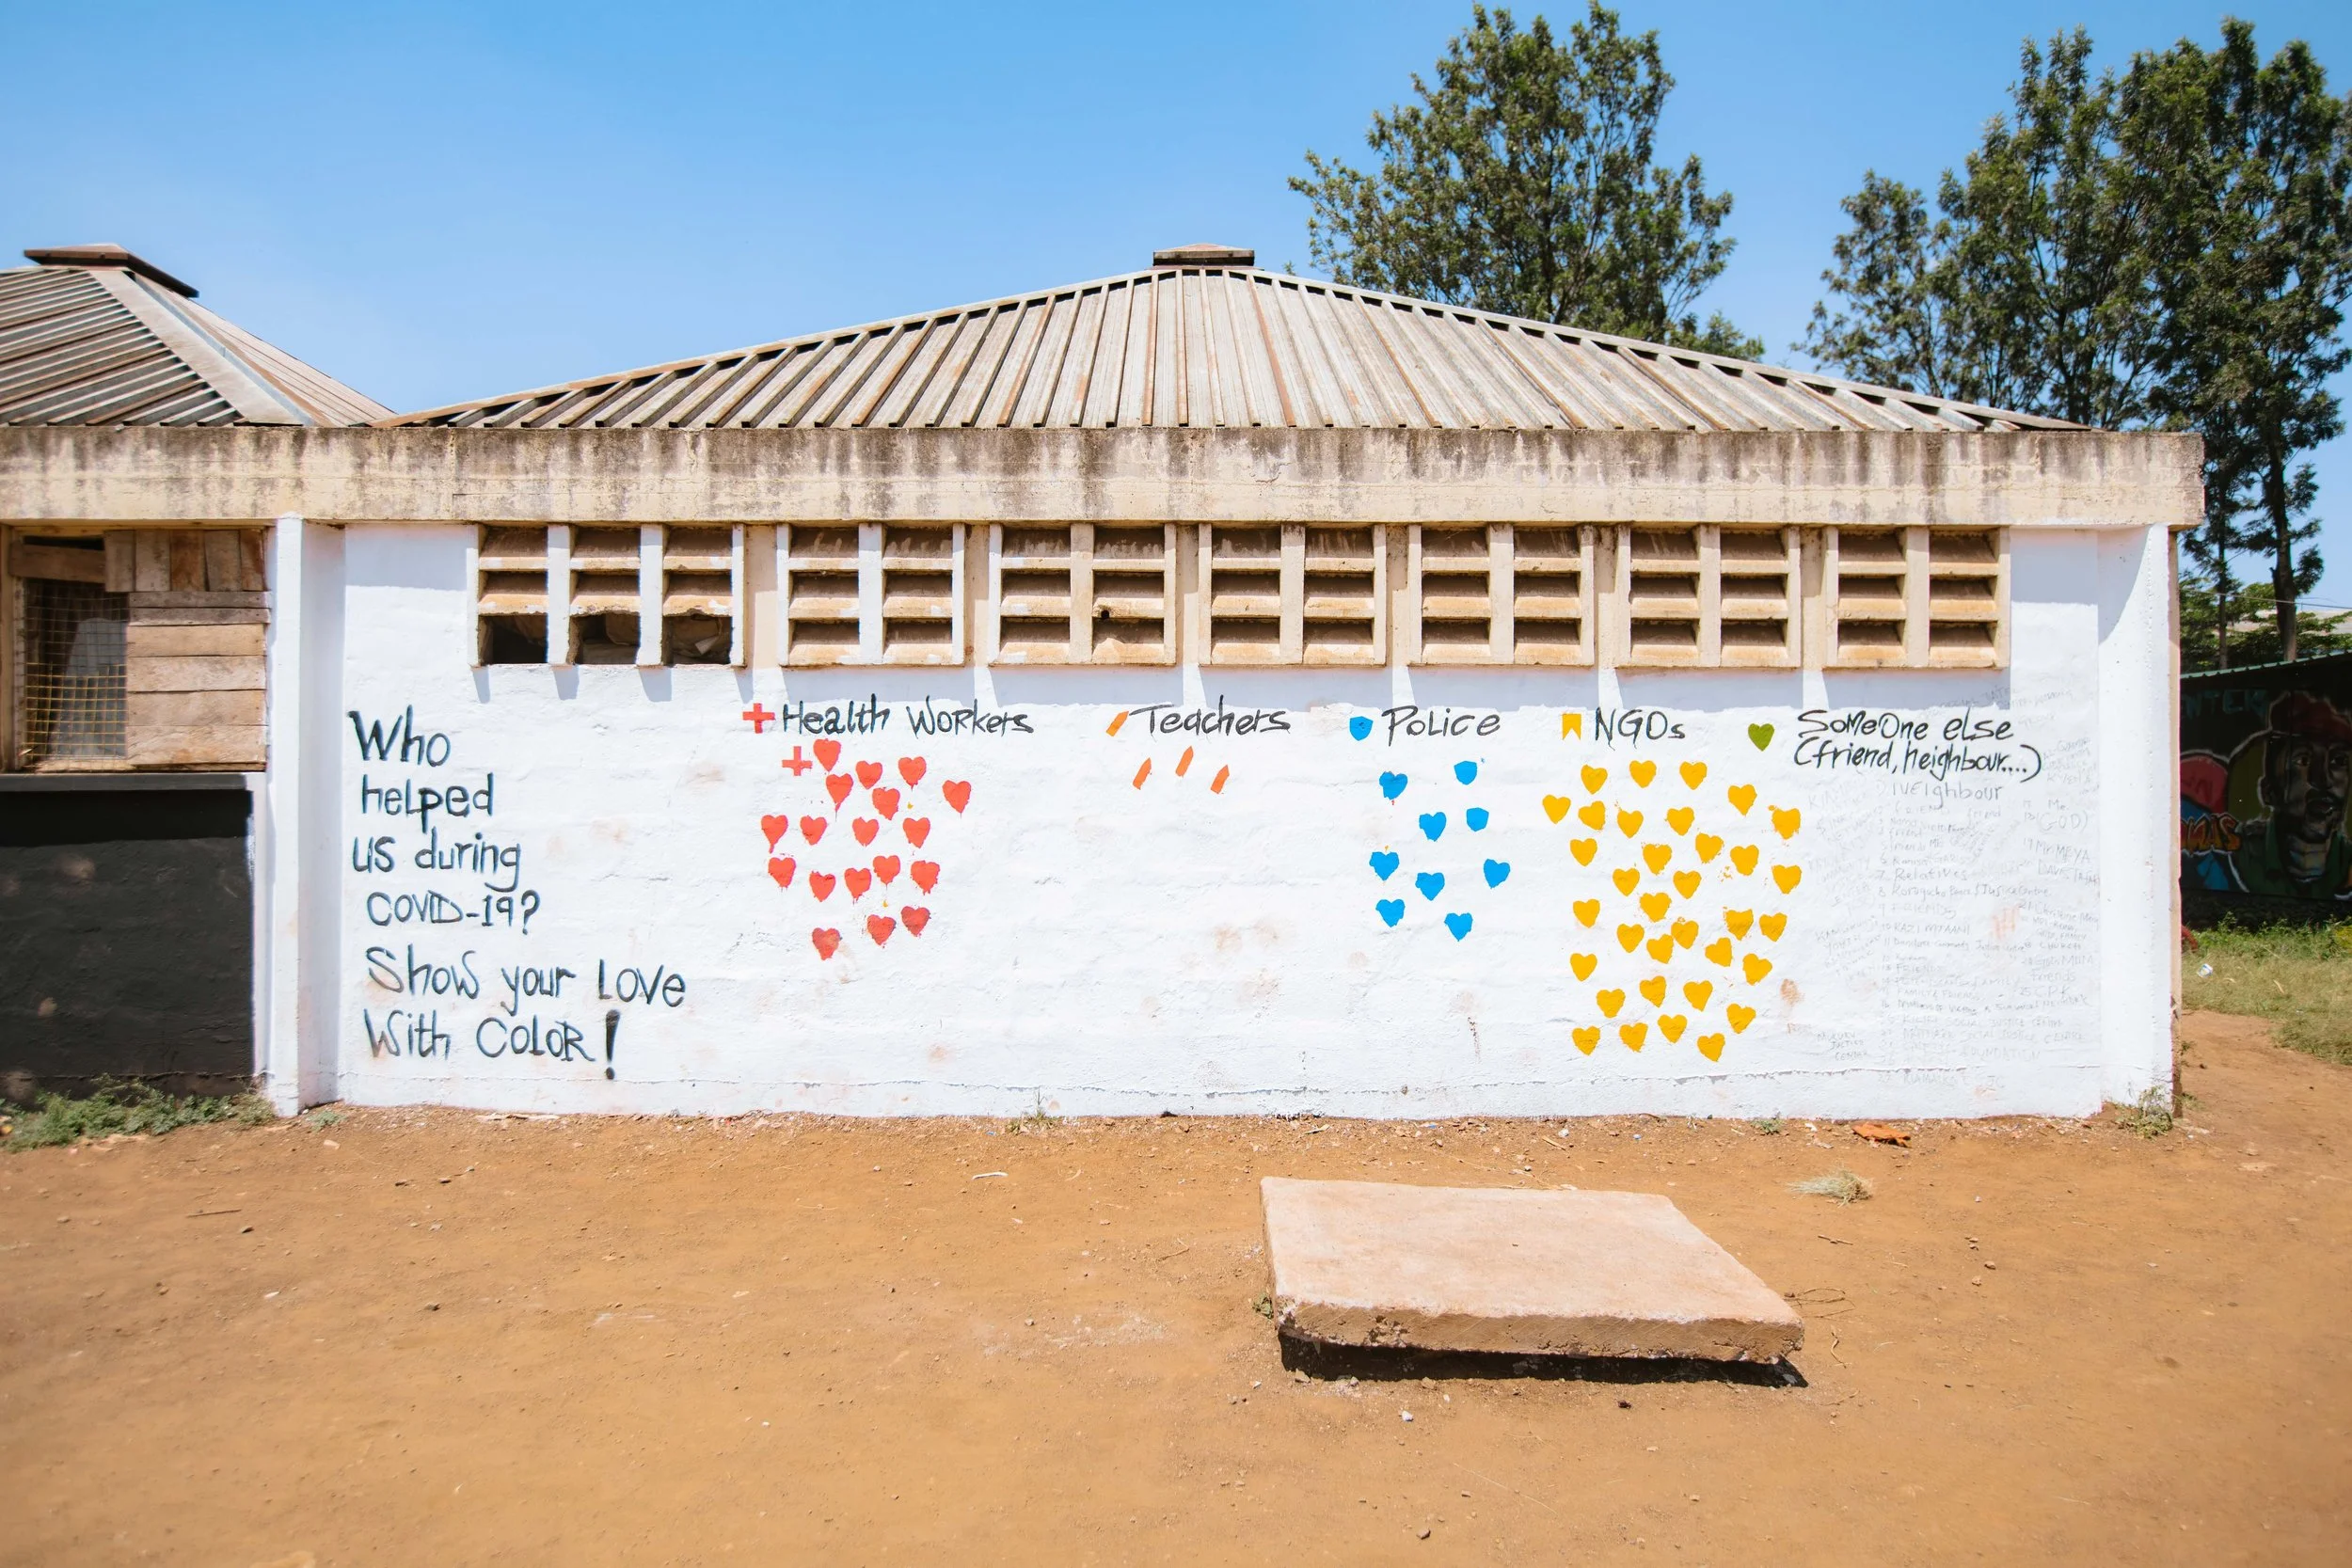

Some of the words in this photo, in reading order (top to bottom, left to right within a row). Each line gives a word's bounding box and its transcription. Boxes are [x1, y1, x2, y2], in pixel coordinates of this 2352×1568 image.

[347, 705, 452, 767] Who
[782, 693, 891, 736] Health
[1129, 694, 1292, 737] Teachers
[1380, 705, 1501, 747] Police
[1594, 706, 1686, 751] NGOs
[362, 771, 494, 833] helped
[414, 826, 522, 894] during
[365, 943, 481, 1000] Show
[500, 965, 577, 1017] your
[363, 1008, 453, 1060] With
